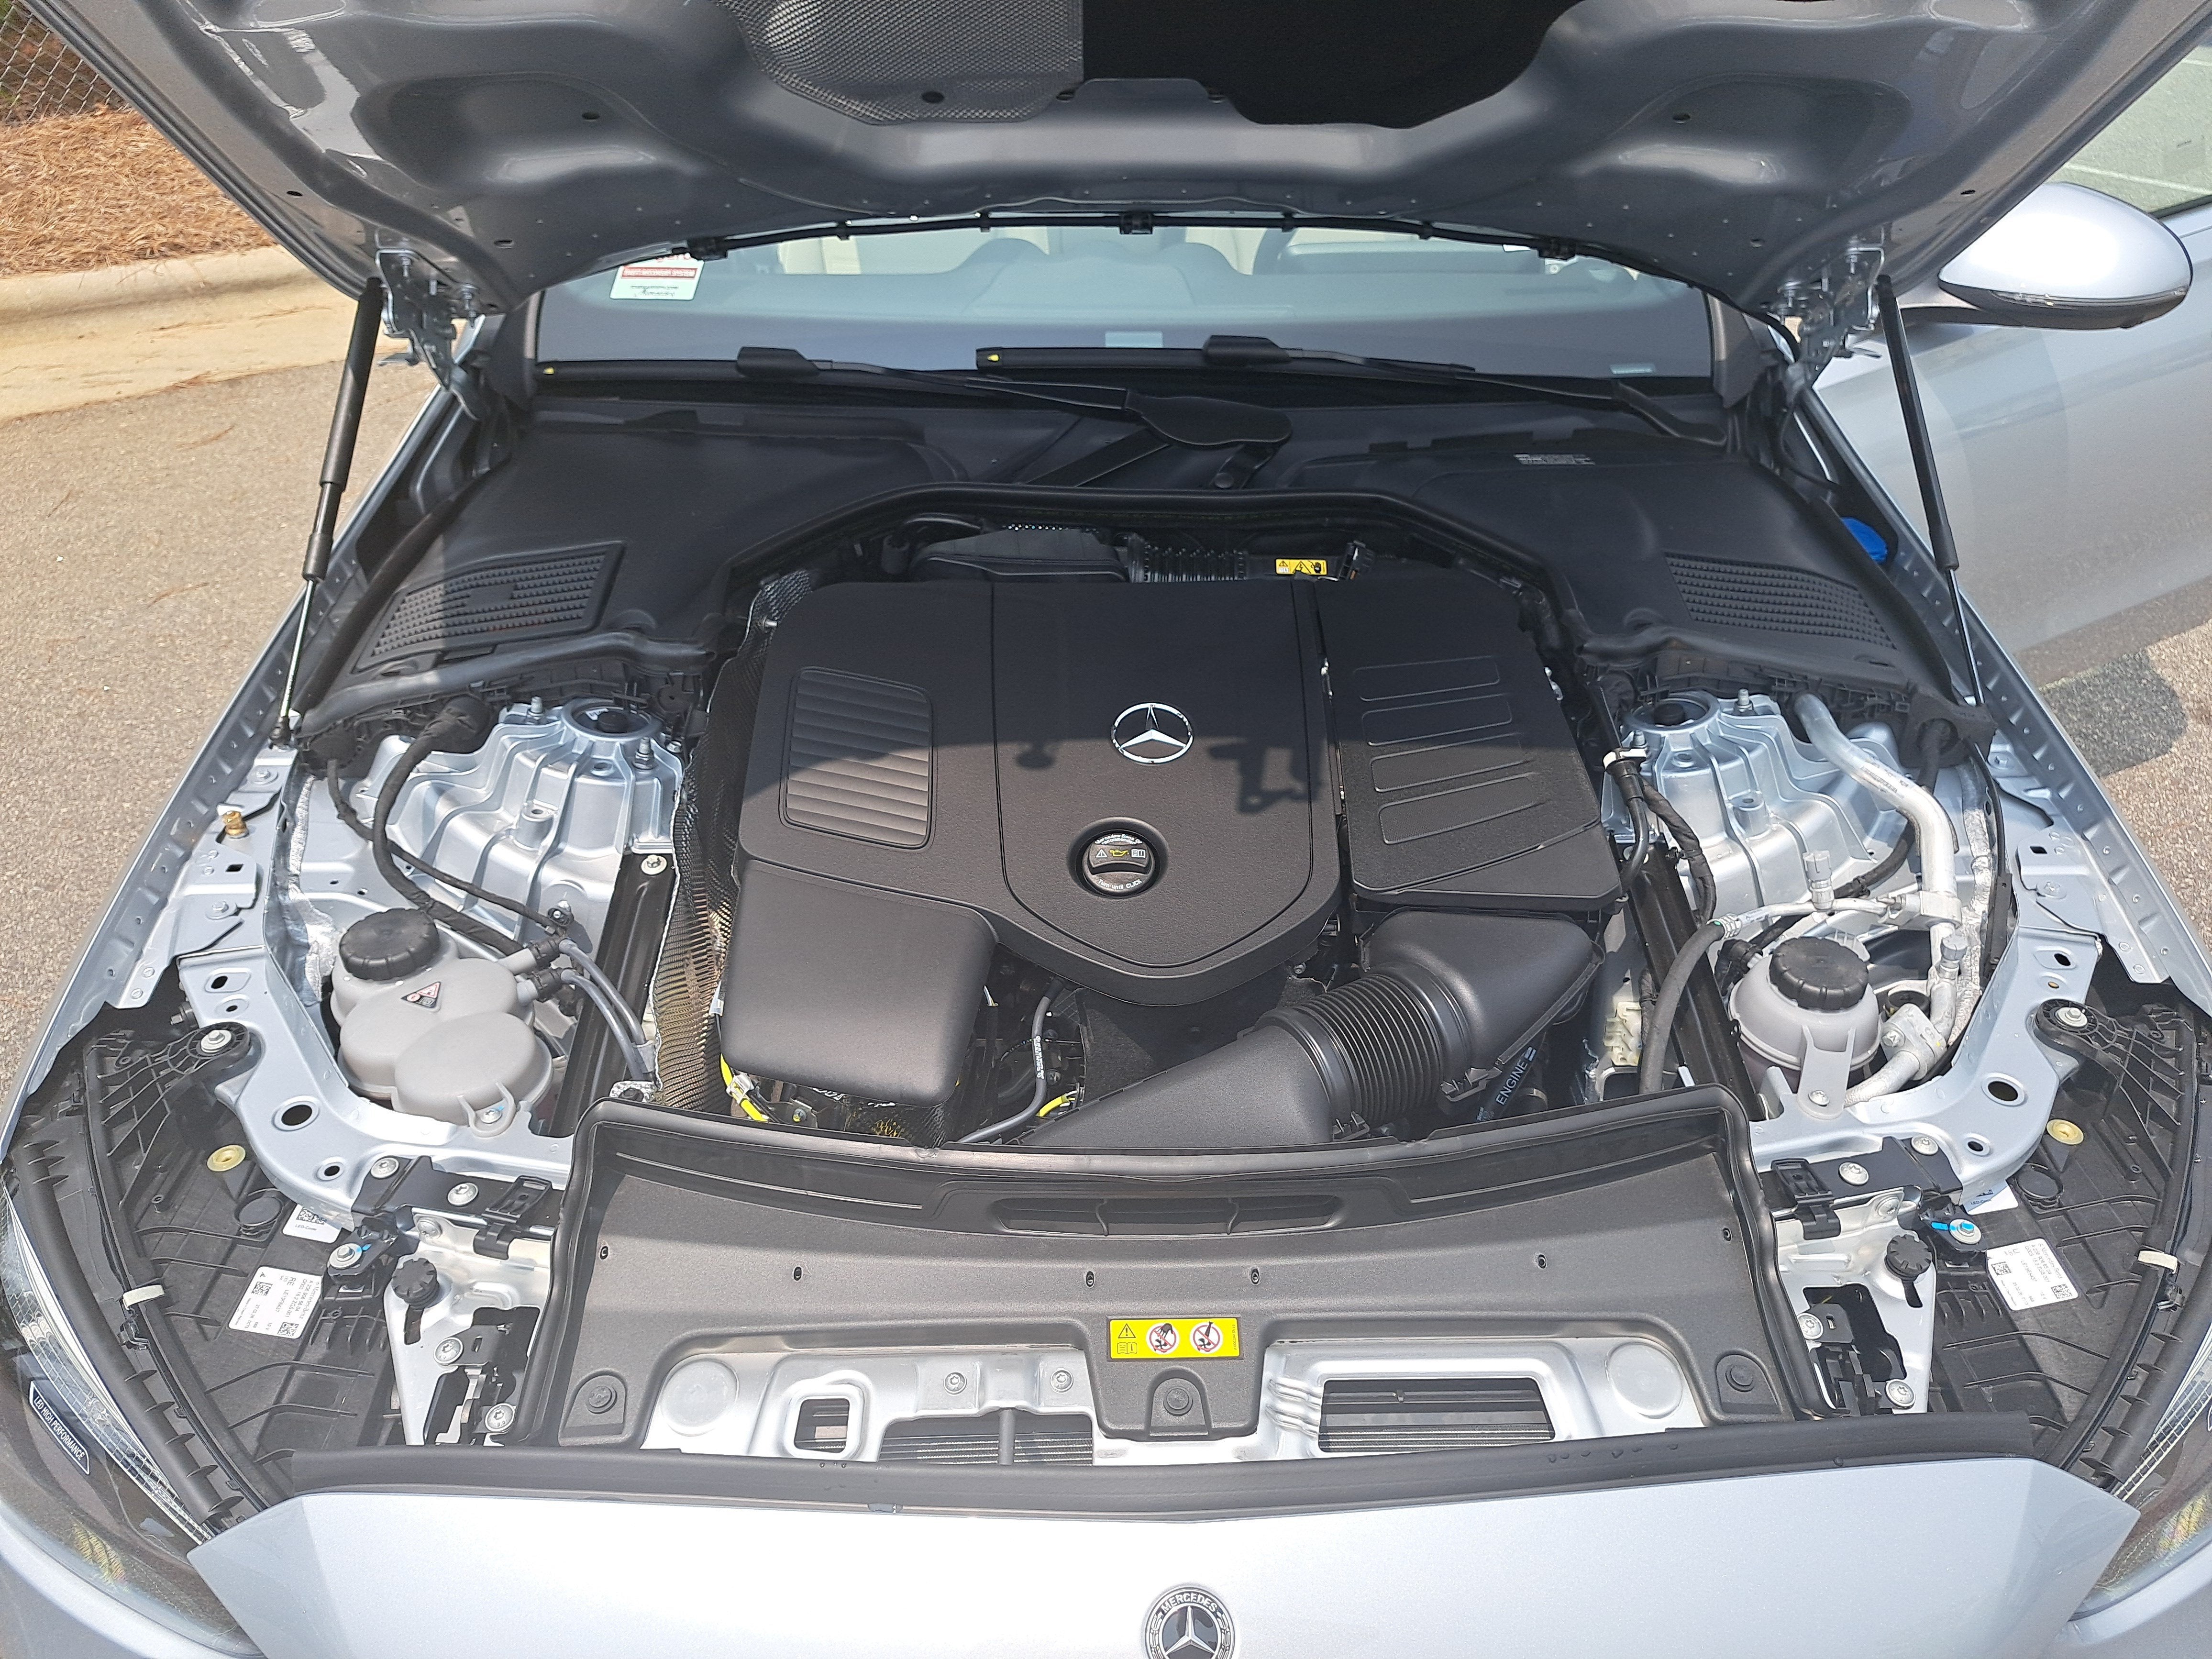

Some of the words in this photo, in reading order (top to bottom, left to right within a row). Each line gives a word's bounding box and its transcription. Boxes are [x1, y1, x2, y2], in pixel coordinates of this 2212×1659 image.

[1098, 879, 1110, 888] Turn
[1126, 879, 1142, 888] CLICK
[1496, 1059, 1528, 1105] ENGINE
[287, 1276, 296, 1286] RE
[33, 1395, 44, 1410] LED
[41, 1406, 55, 1424] HIGH
[51, 1420, 85, 1461] PERFORMANCE
[1161, 1592, 1218, 1613] MERCEDES
